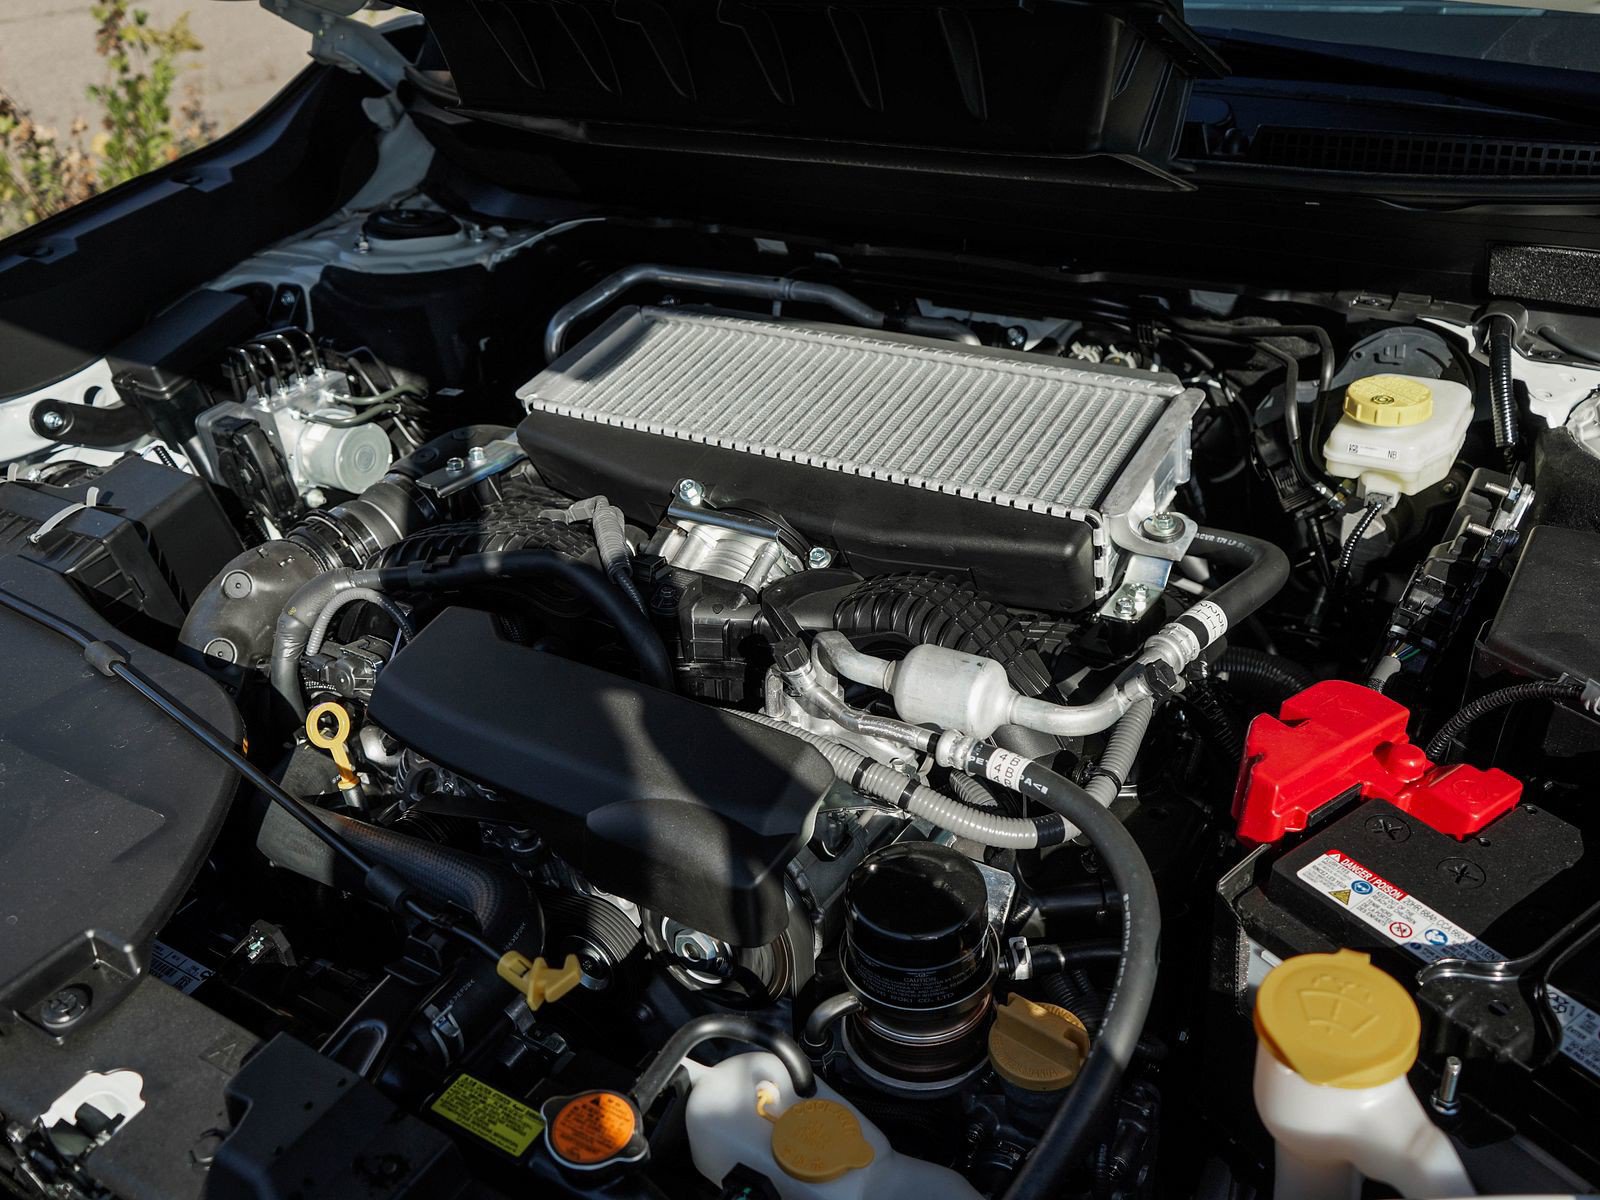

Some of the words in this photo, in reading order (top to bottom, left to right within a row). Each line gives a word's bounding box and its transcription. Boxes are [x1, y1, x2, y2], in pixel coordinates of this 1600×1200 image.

[1341, 858, 1373, 881] DANGER
[1373, 879, 1404, 900] POISON
[1434, 919, 1454, 931] CCA
